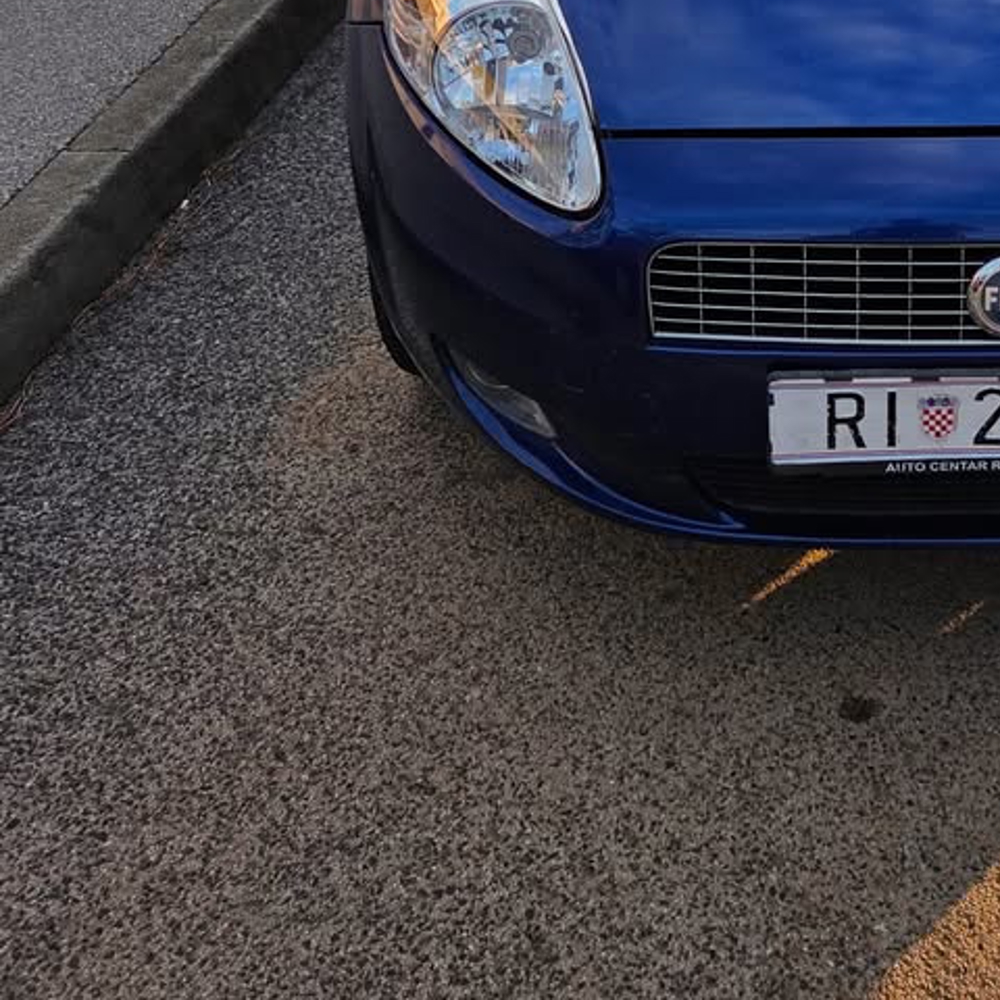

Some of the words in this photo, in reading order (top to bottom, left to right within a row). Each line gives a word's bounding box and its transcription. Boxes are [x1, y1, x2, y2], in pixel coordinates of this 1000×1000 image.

[826, 391, 897, 449] RI
[885, 461, 926, 473] AUTO
[929, 460, 988, 472] CENTAR
